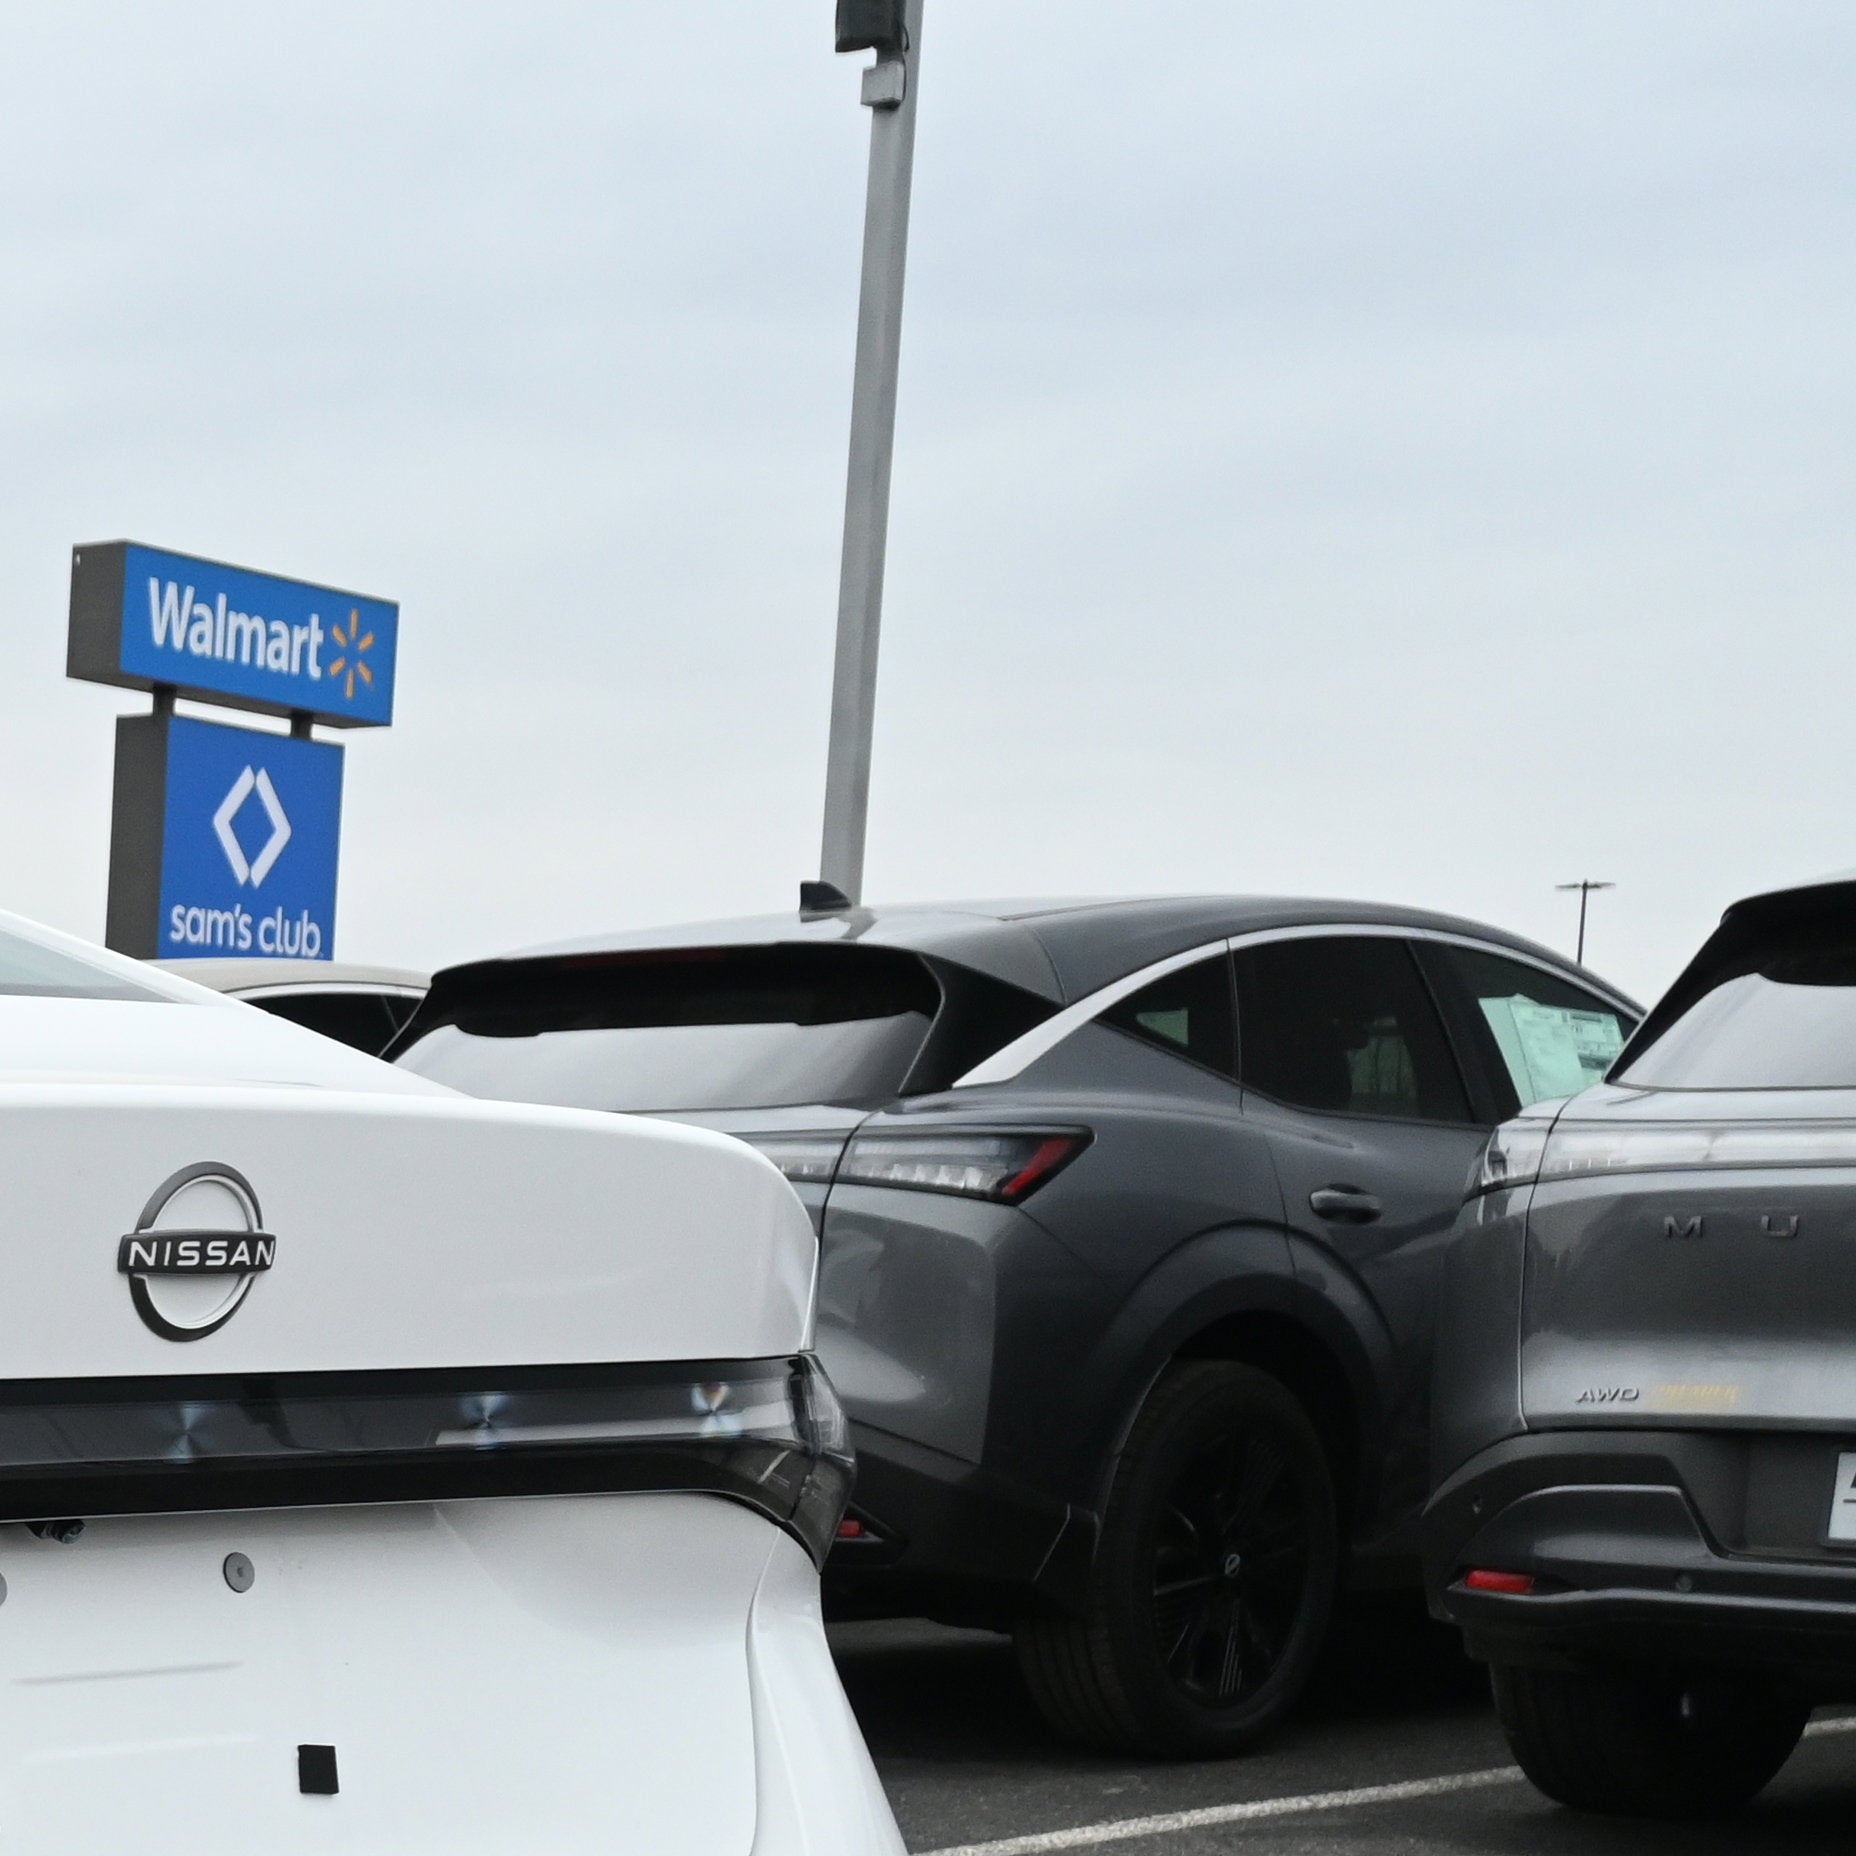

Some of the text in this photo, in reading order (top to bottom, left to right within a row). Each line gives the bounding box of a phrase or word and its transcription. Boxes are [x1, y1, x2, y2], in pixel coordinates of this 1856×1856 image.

[149, 576, 324, 680] Walmart
[170, 903, 321, 958] sam's club
[128, 1241, 275, 1267] NISSAN
[1576, 1386, 1640, 1404] AWD
